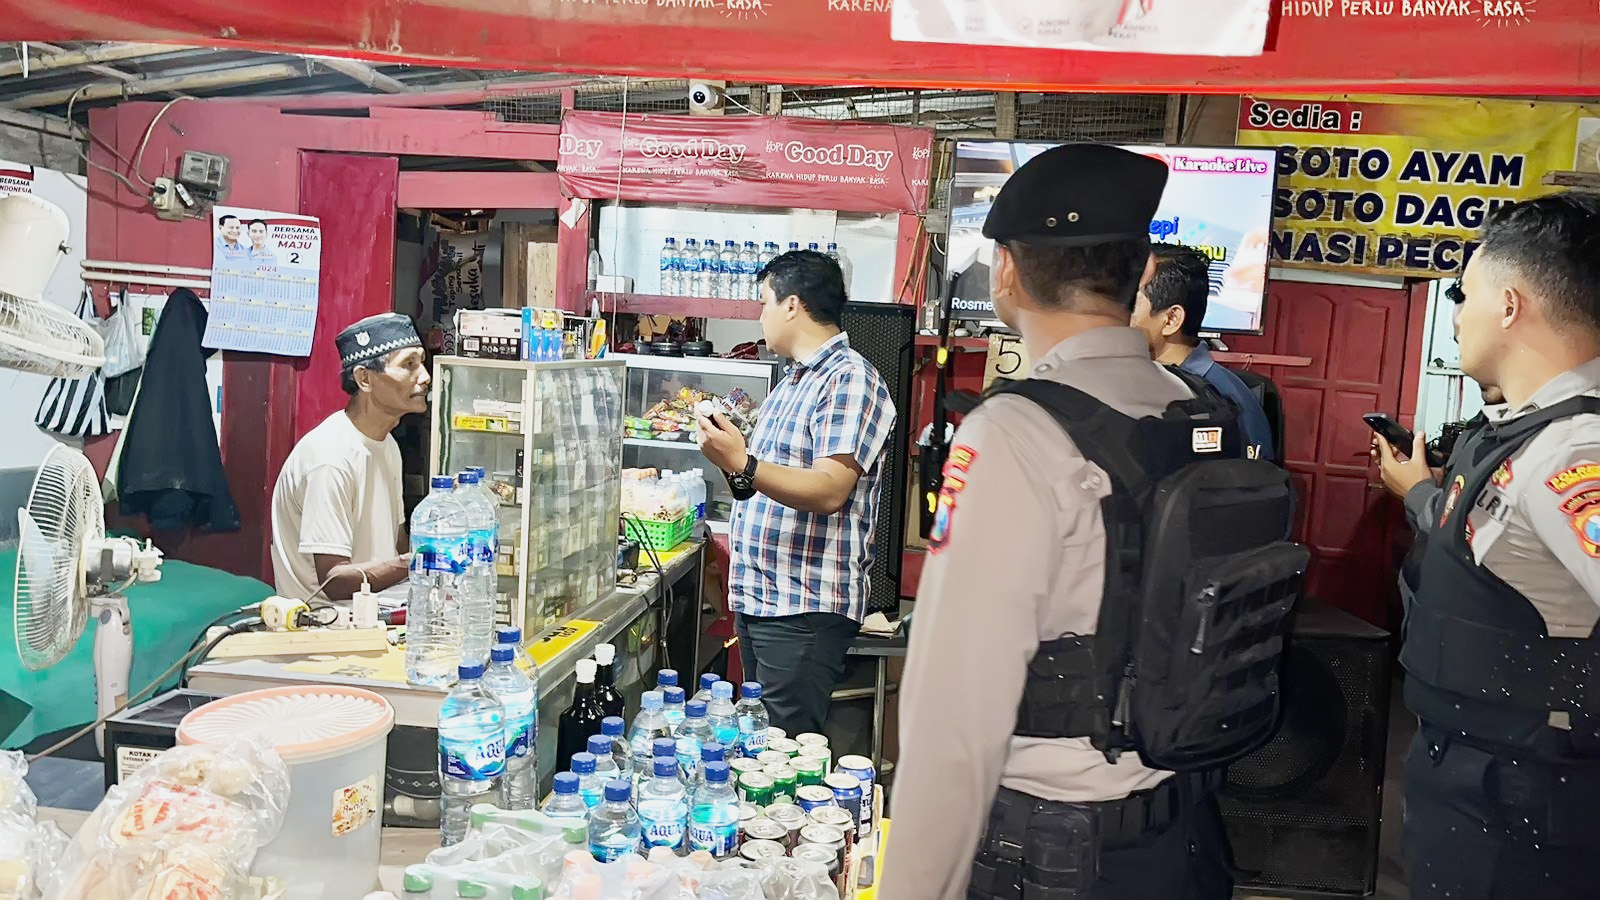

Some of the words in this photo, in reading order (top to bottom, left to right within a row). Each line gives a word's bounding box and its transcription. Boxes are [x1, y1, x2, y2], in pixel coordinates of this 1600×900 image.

[1281, 0, 1333, 17] HIDUP
[1341, 0, 1394, 16] PERLU
[1401, 0, 1471, 16] BANYAK
[1483, 1, 1525, 17] RASA
[1249, 102, 1341, 130] Sedia
[559, 134, 602, 160] Day
[640, 136, 699, 158] Good
[700, 138, 747, 164] Day
[766, 140, 784, 153] KOPI
[785, 141, 846, 167] Good
[847, 144, 893, 171] Day
[912, 147, 930, 160] KOPI
[1174, 156, 1235, 173] Karaoke
[1236, 159, 1267, 174] Live
[1277, 145, 1391, 180] SOTO
[1399, 150, 1524, 187] AYAM
[766, 171, 795, 180] KARENA
[797, 172, 816, 181] HIDUP
[818, 174, 838, 182] PERLU
[840, 175, 866, 184] BANYAK
[869, 177, 886, 185] RASA
[1275, 188, 1385, 224] SOTO
[271, 233, 319, 242] INDONESIA
[274, 225, 316, 235] BERSAMA
[277, 240, 312, 250] MAJU
[1270, 231, 1367, 266] NASI
[290, 252, 300, 265] 2
[256, 264, 277, 273] 2024
[995, 338, 1022, 375] 5
[650, 823, 682, 838] AQUA
